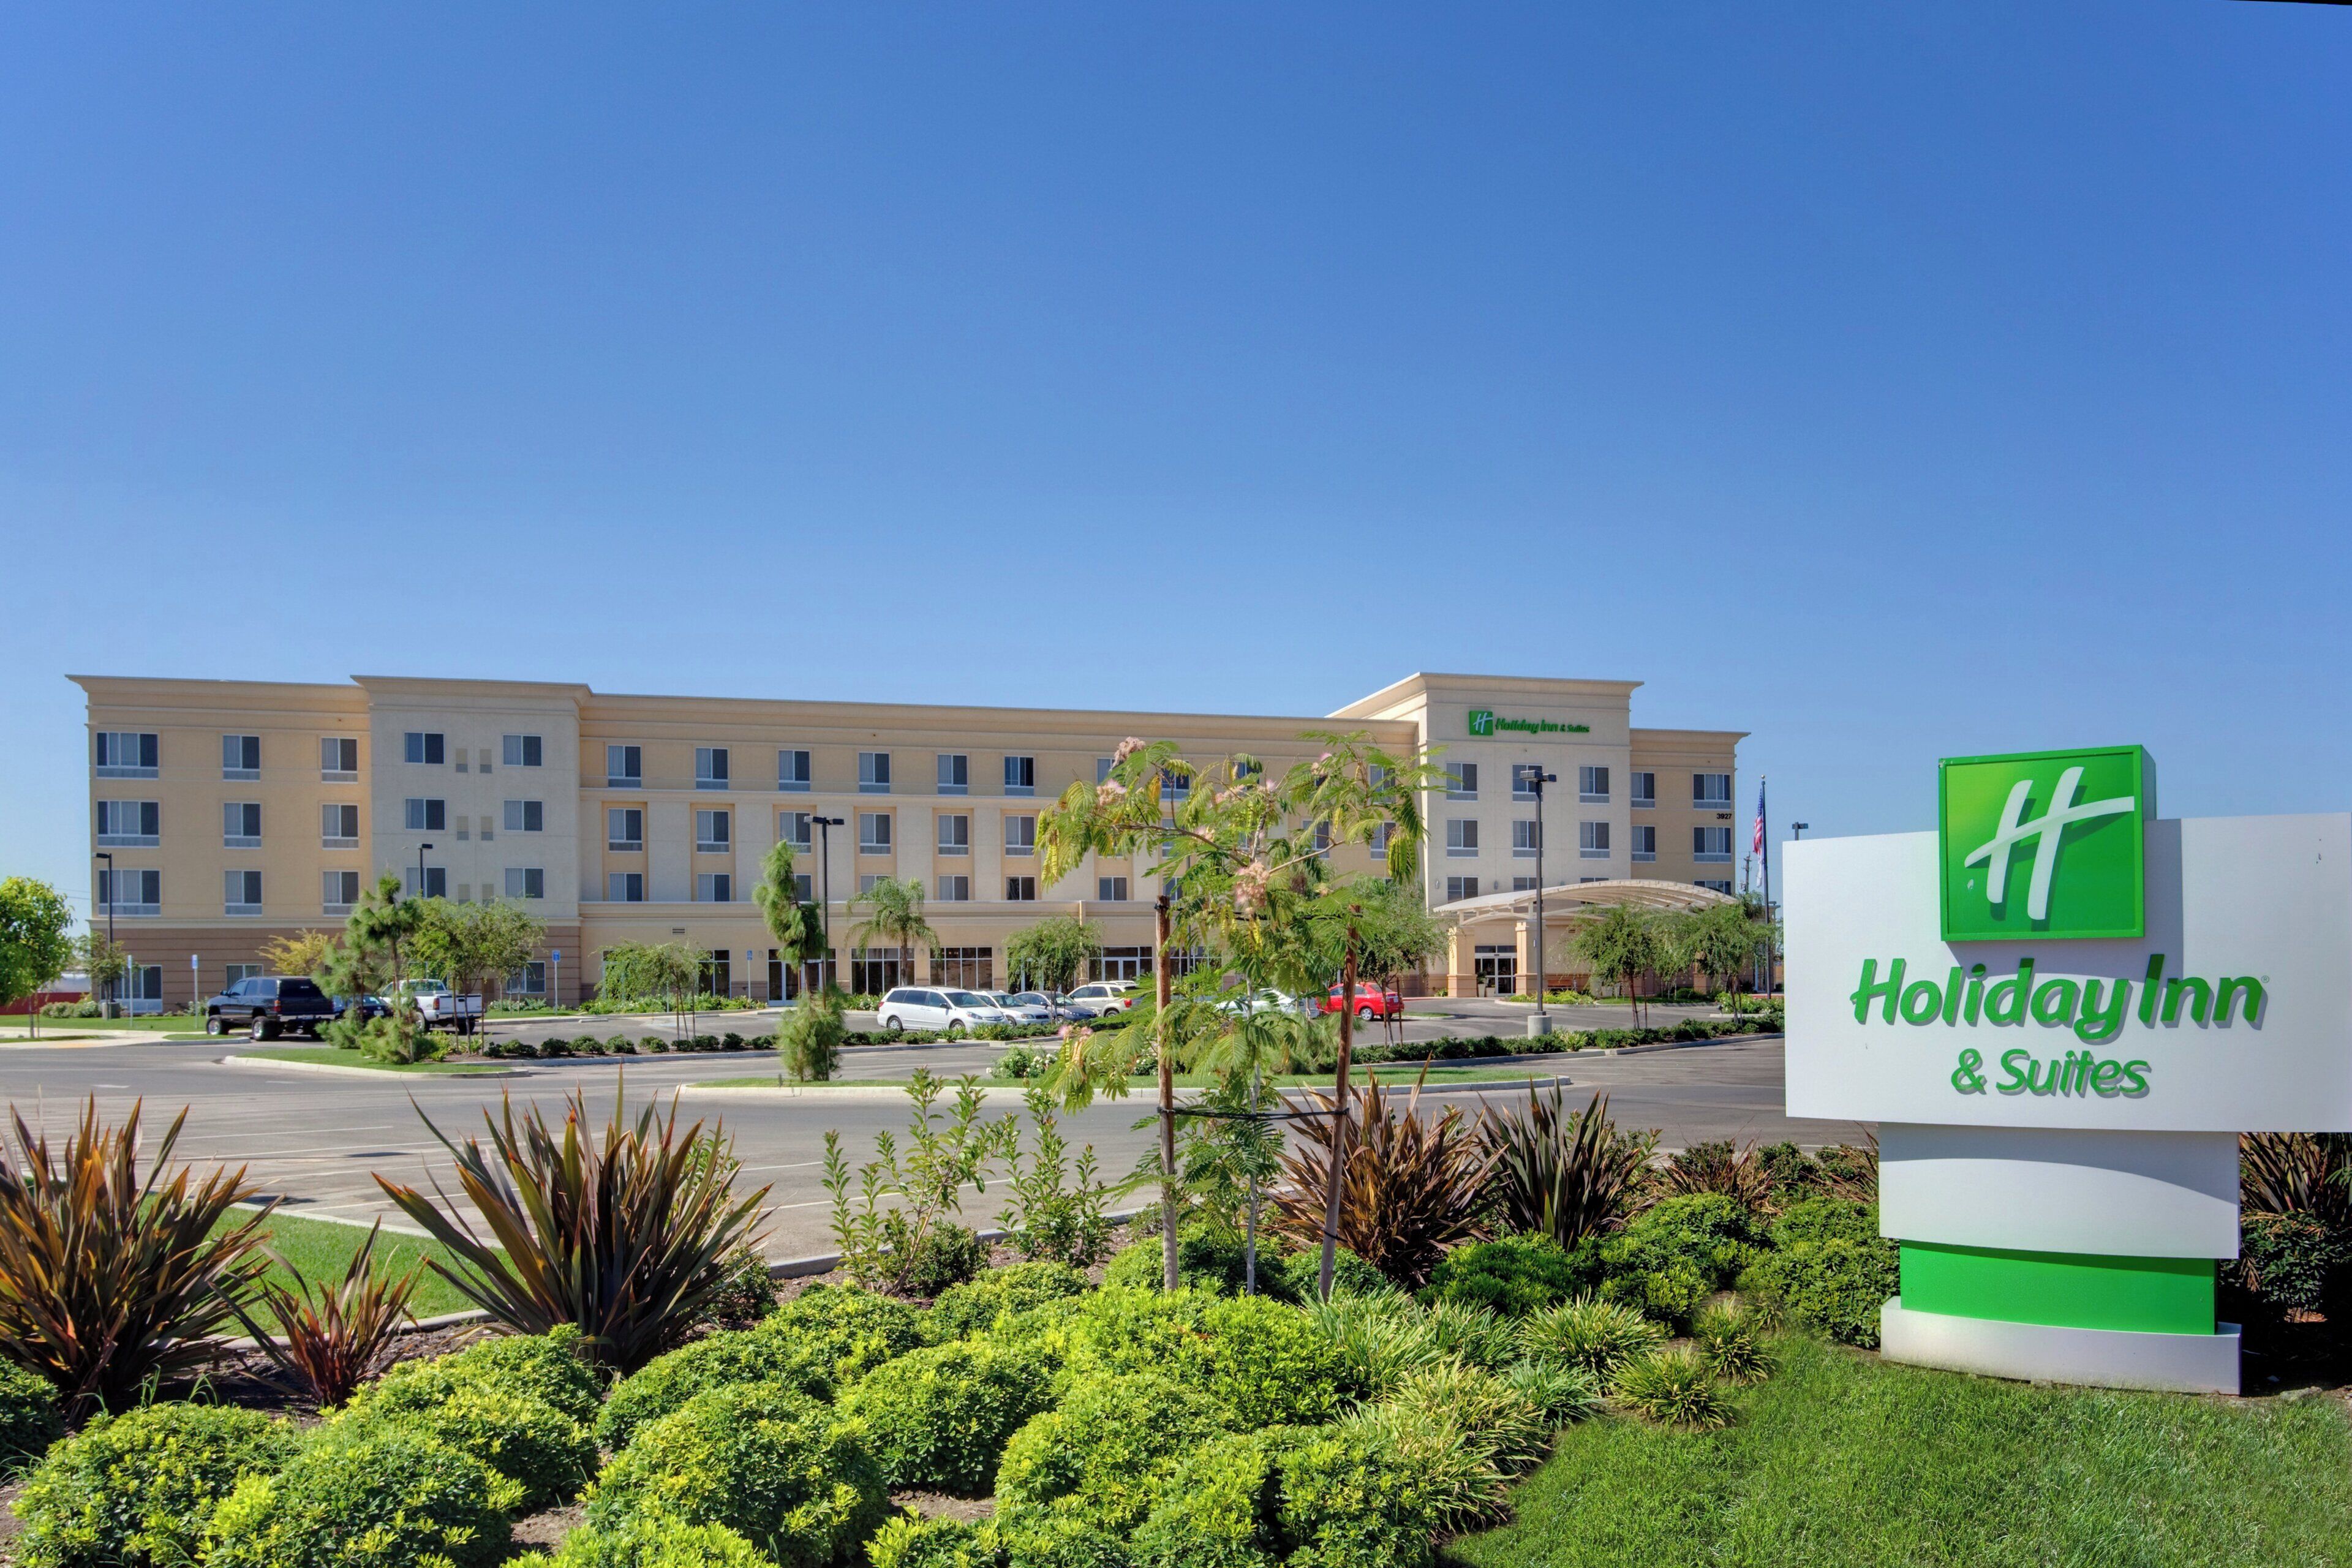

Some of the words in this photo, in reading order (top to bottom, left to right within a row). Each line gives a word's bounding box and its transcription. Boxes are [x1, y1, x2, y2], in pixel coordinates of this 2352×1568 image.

[1495, 718, 1539, 734] Holiday
[1540, 719, 1558, 732] Inn
[1567, 724, 1589, 733] Suites
[1850, 957, 2130, 1041] Holiday
[1951, 1048, 1986, 1093] &
[1996, 1048, 2151, 1095] Suites
